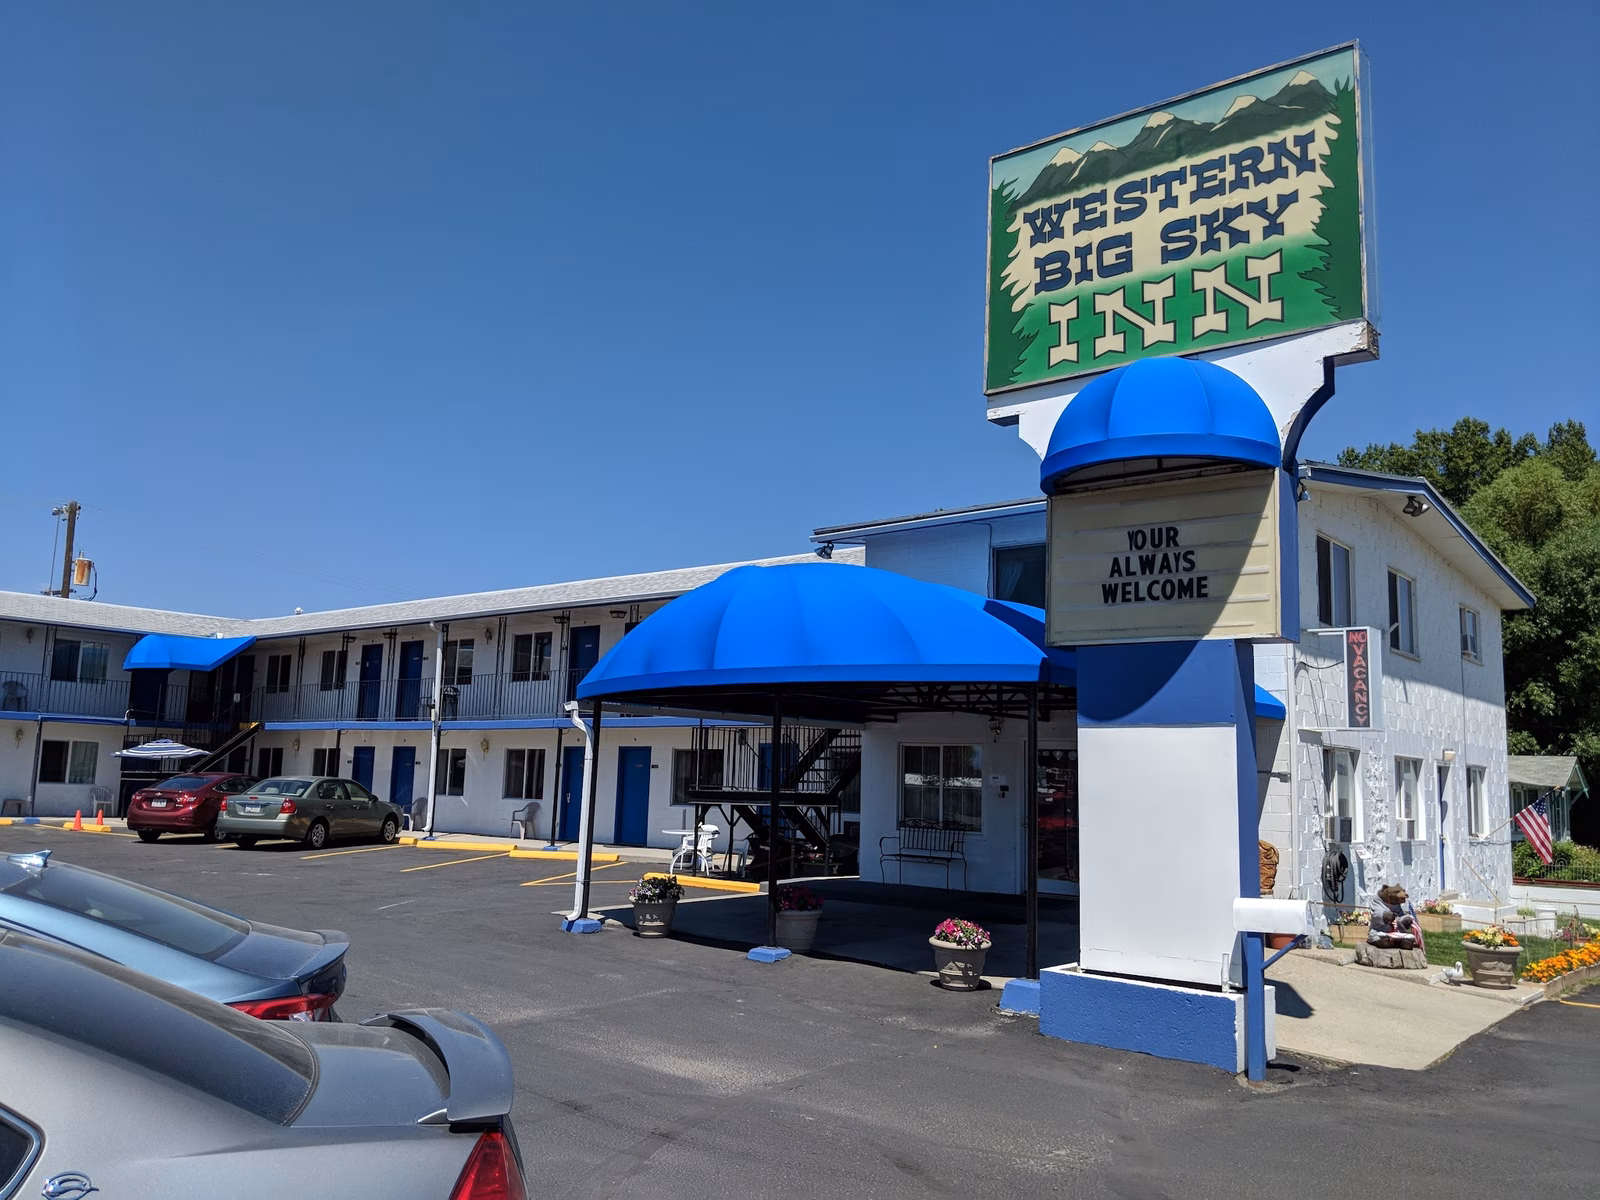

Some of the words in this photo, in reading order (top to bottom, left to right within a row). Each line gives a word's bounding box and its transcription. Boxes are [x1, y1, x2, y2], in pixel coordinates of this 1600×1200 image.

[1023, 129, 1316, 248] WESTERN
[1034, 232, 1133, 296] BIG
[1160, 189, 1299, 264] SKY
[1048, 249, 1285, 369] INN
[1109, 550, 1196, 578] ALWAYS
[1127, 526, 1180, 551] YOUR
[1101, 576, 1209, 604] WELCOME
[1348, 631, 1368, 643] NO
[1352, 643, 1368, 726] VACANCY
